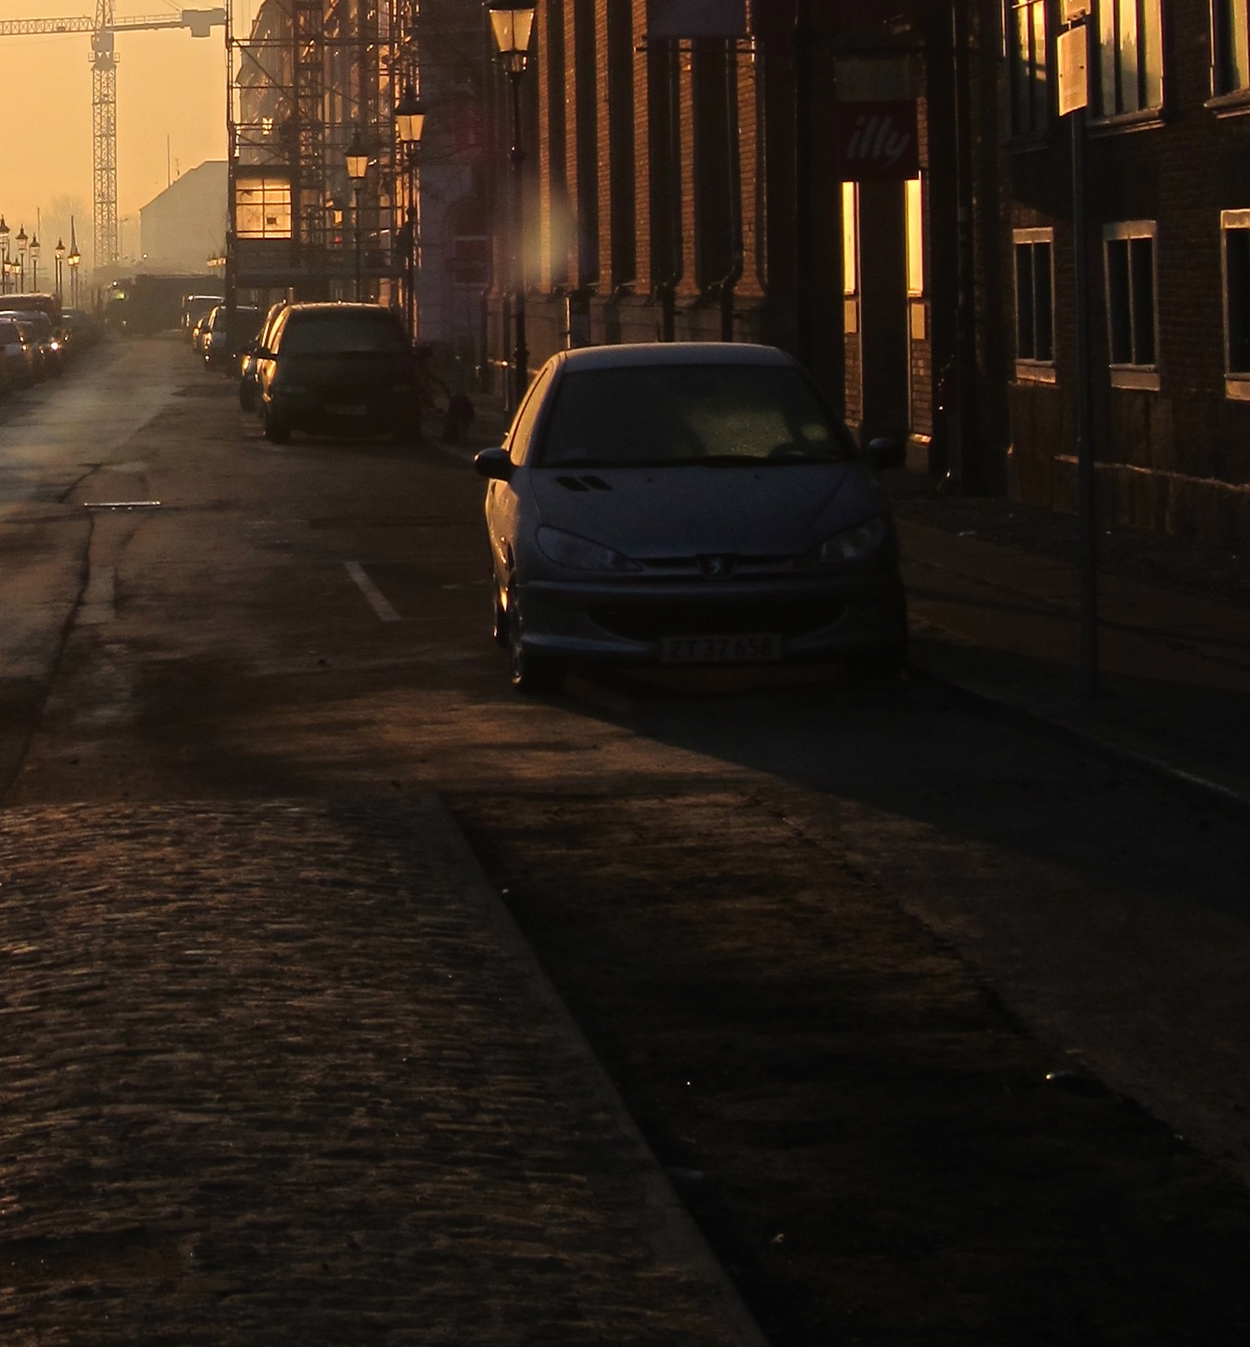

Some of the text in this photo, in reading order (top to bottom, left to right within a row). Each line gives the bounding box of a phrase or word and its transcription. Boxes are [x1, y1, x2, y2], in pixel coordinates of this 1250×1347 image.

[847, 115, 911, 169] illy
[670, 637, 773, 658] ZT 37 658
